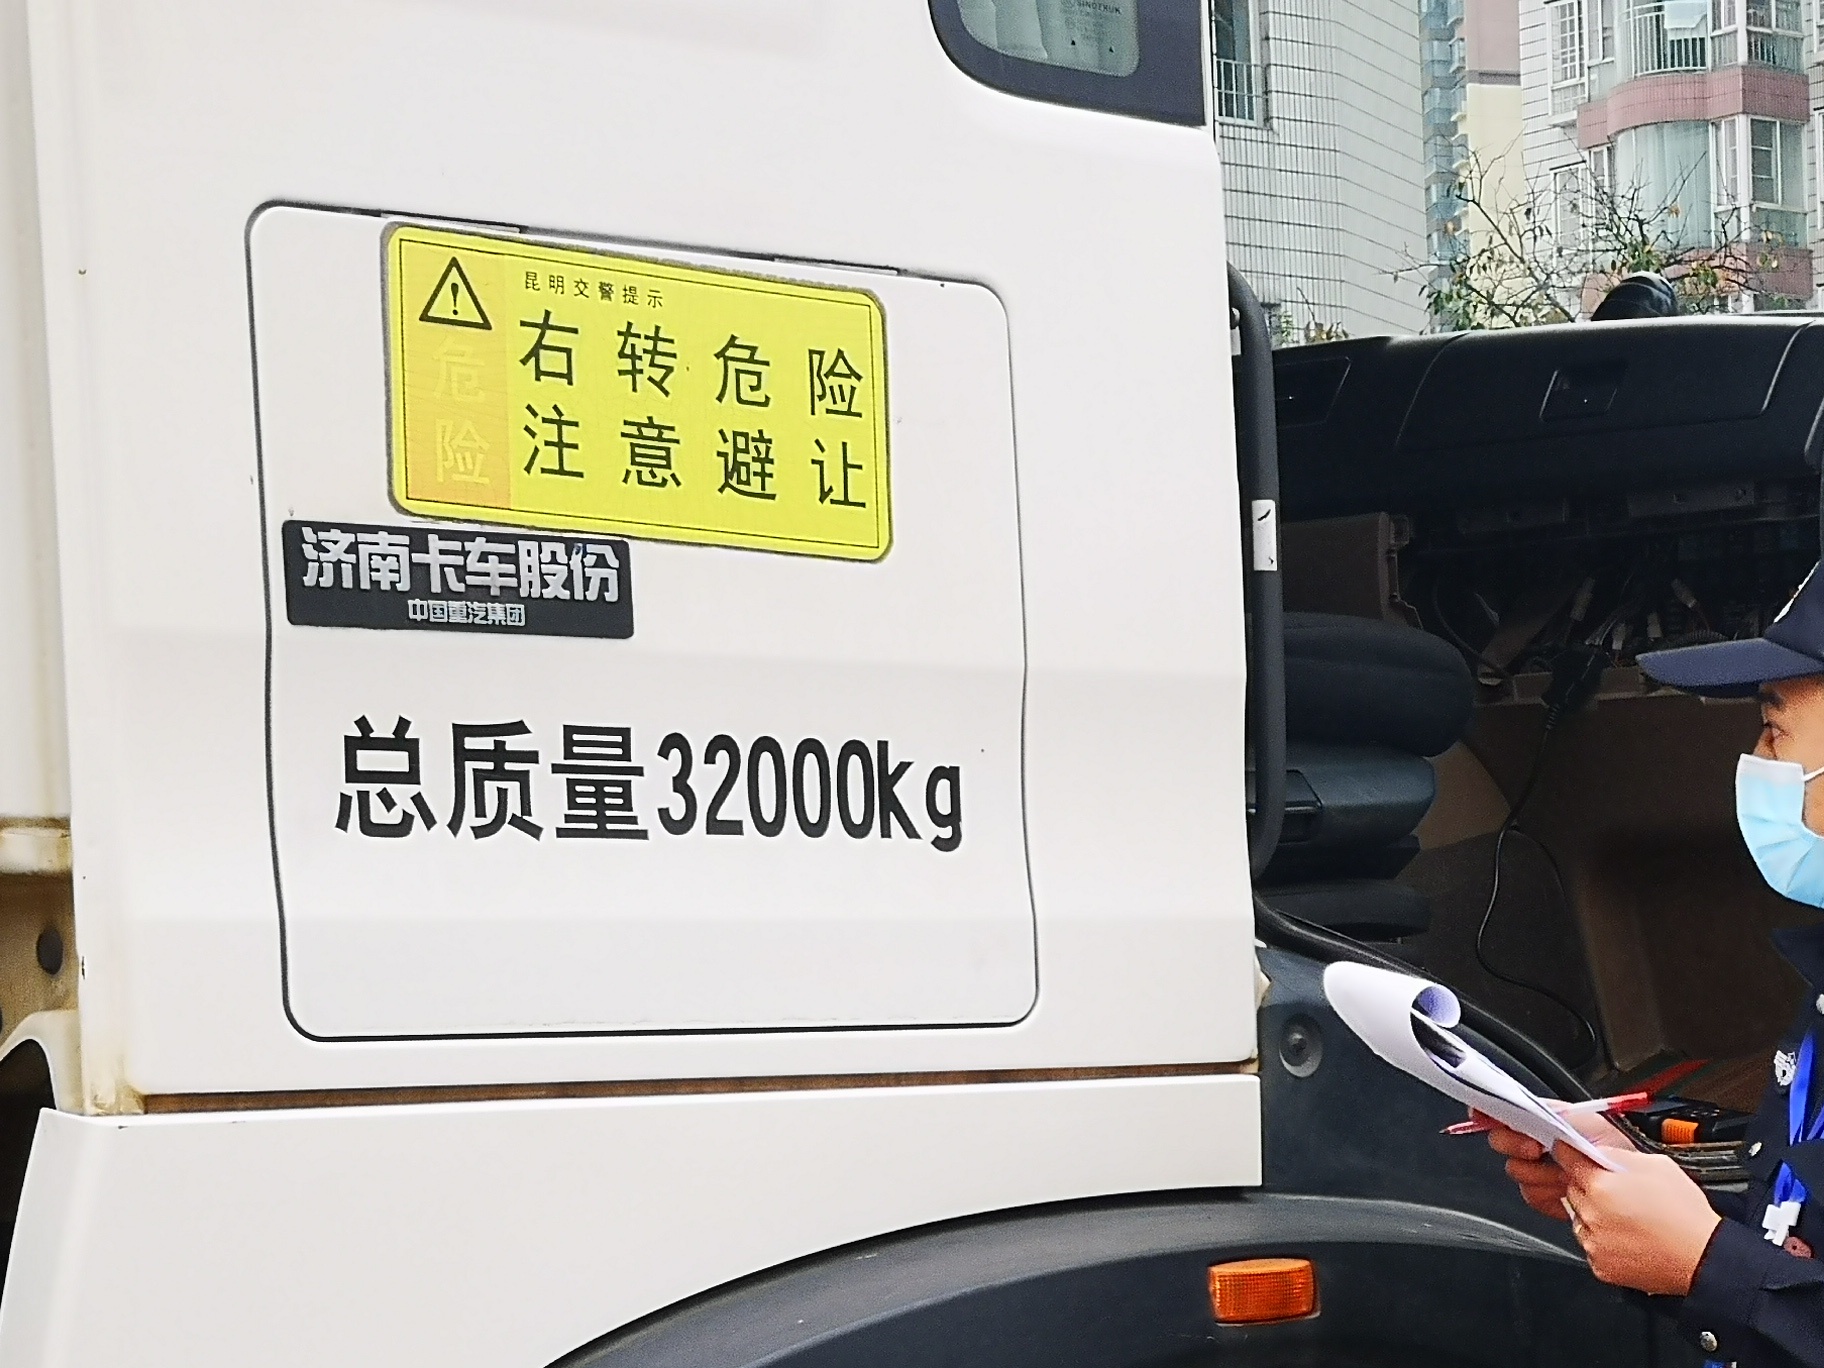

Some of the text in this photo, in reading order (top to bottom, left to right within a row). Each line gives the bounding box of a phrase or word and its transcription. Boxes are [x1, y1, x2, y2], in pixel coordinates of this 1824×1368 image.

[525, 271, 664, 309] 昆明交警提示
[432, 336, 490, 487] 危险
[519, 309, 863, 419] 右转危险
[522, 403, 867, 509] 注意避让
[302, 526, 619, 602] 济南卡车股份
[408, 599, 526, 627] 中国重汽集团
[334, 714, 963, 853] 总质量32000kg
